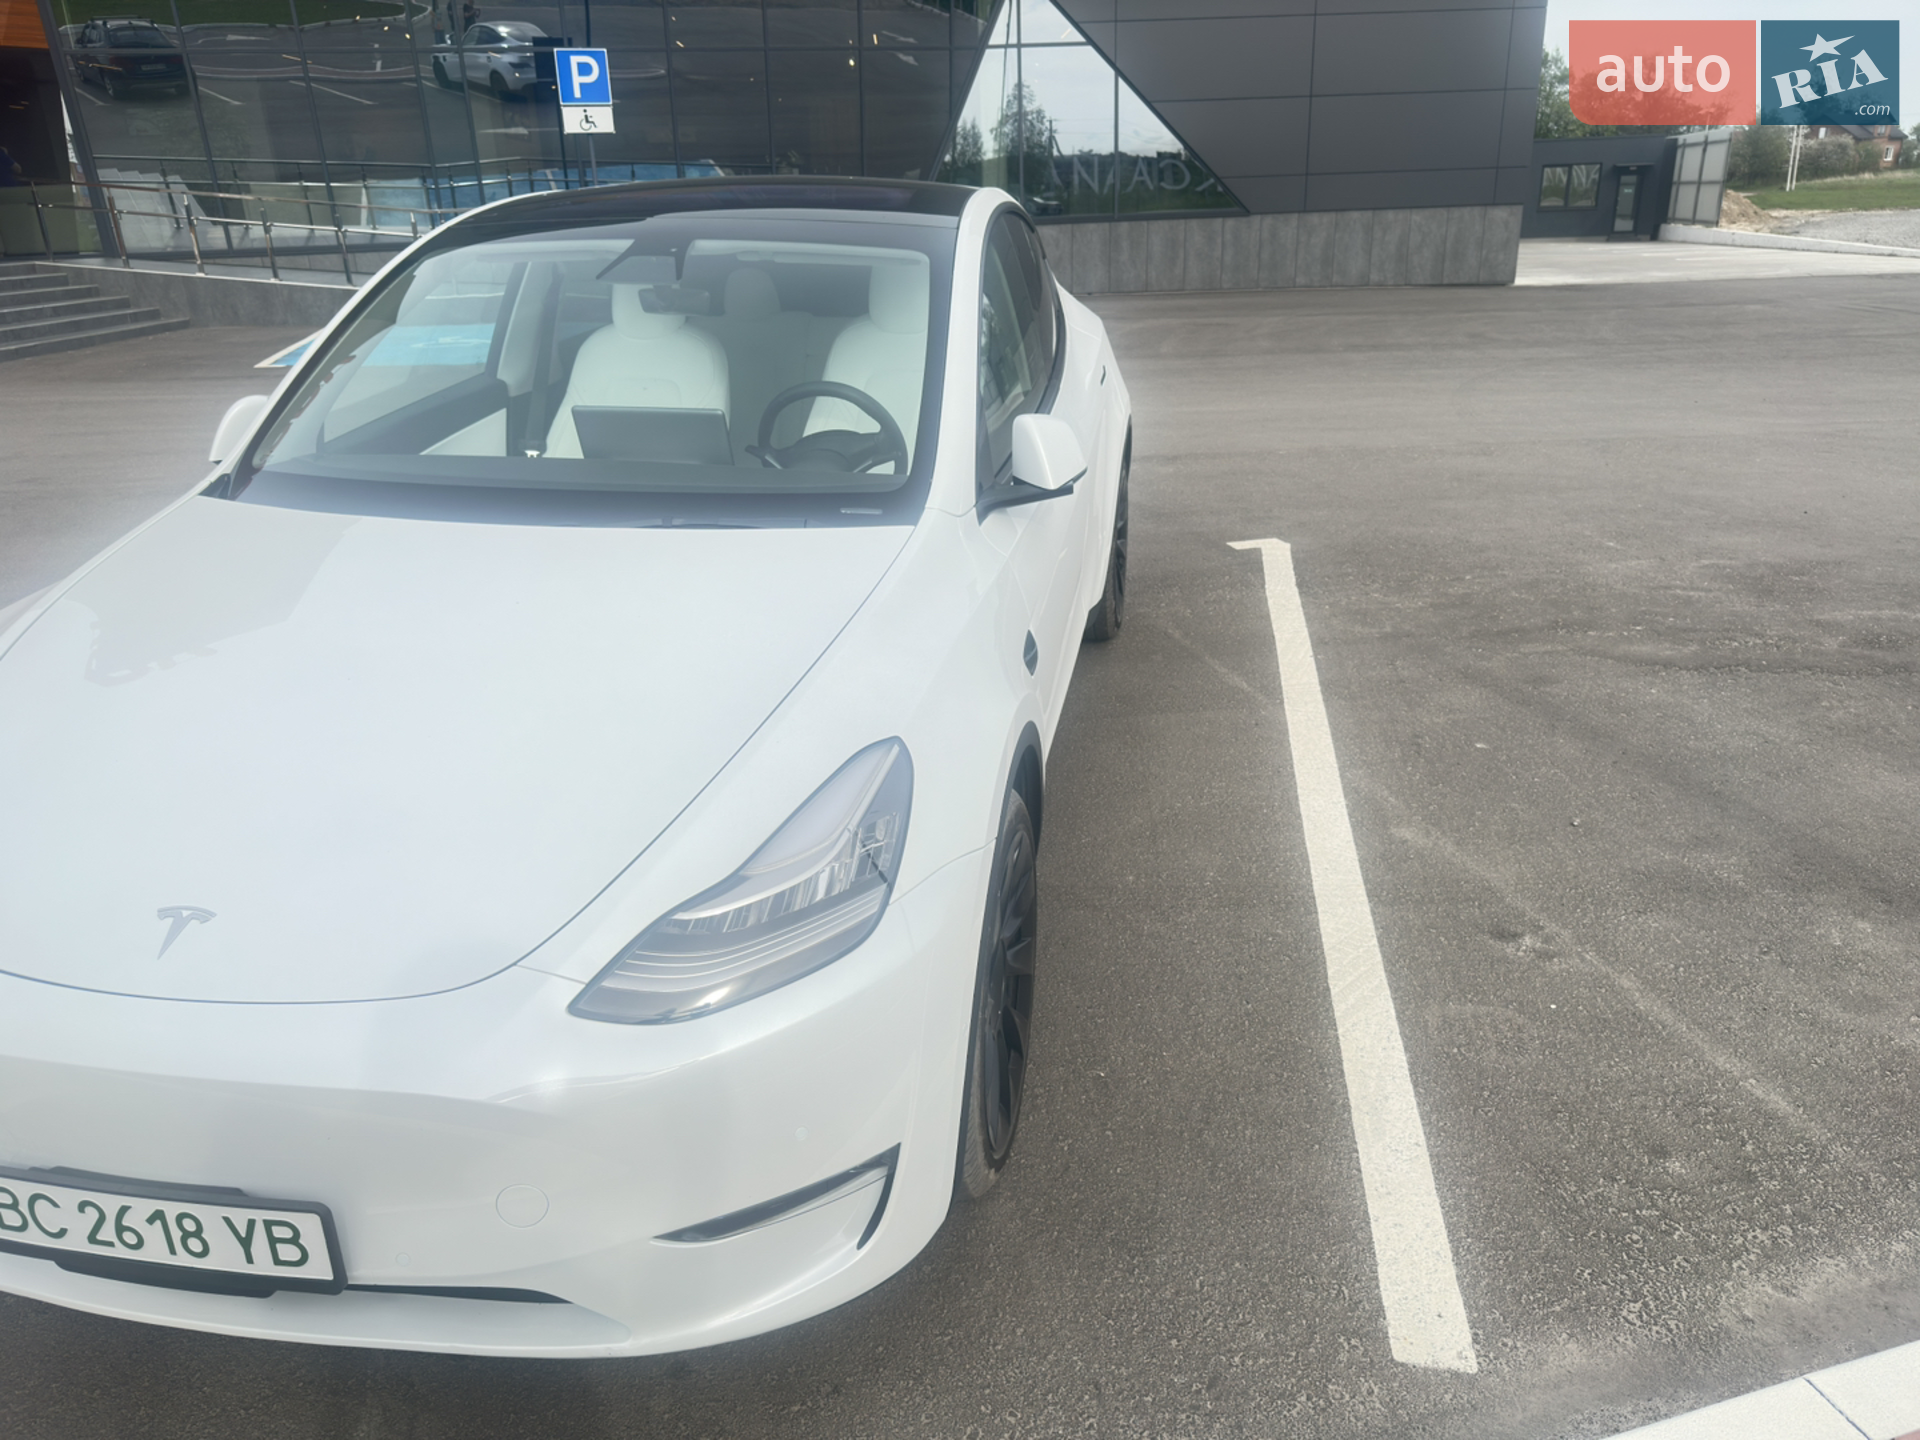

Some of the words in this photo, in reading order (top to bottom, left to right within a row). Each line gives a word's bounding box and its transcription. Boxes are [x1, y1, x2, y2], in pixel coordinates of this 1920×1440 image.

[570, 55, 600, 98] P
[0, 1186, 68, 1239] BC
[77, 1200, 210, 1259] 2618
[221, 1215, 309, 1267] YB
